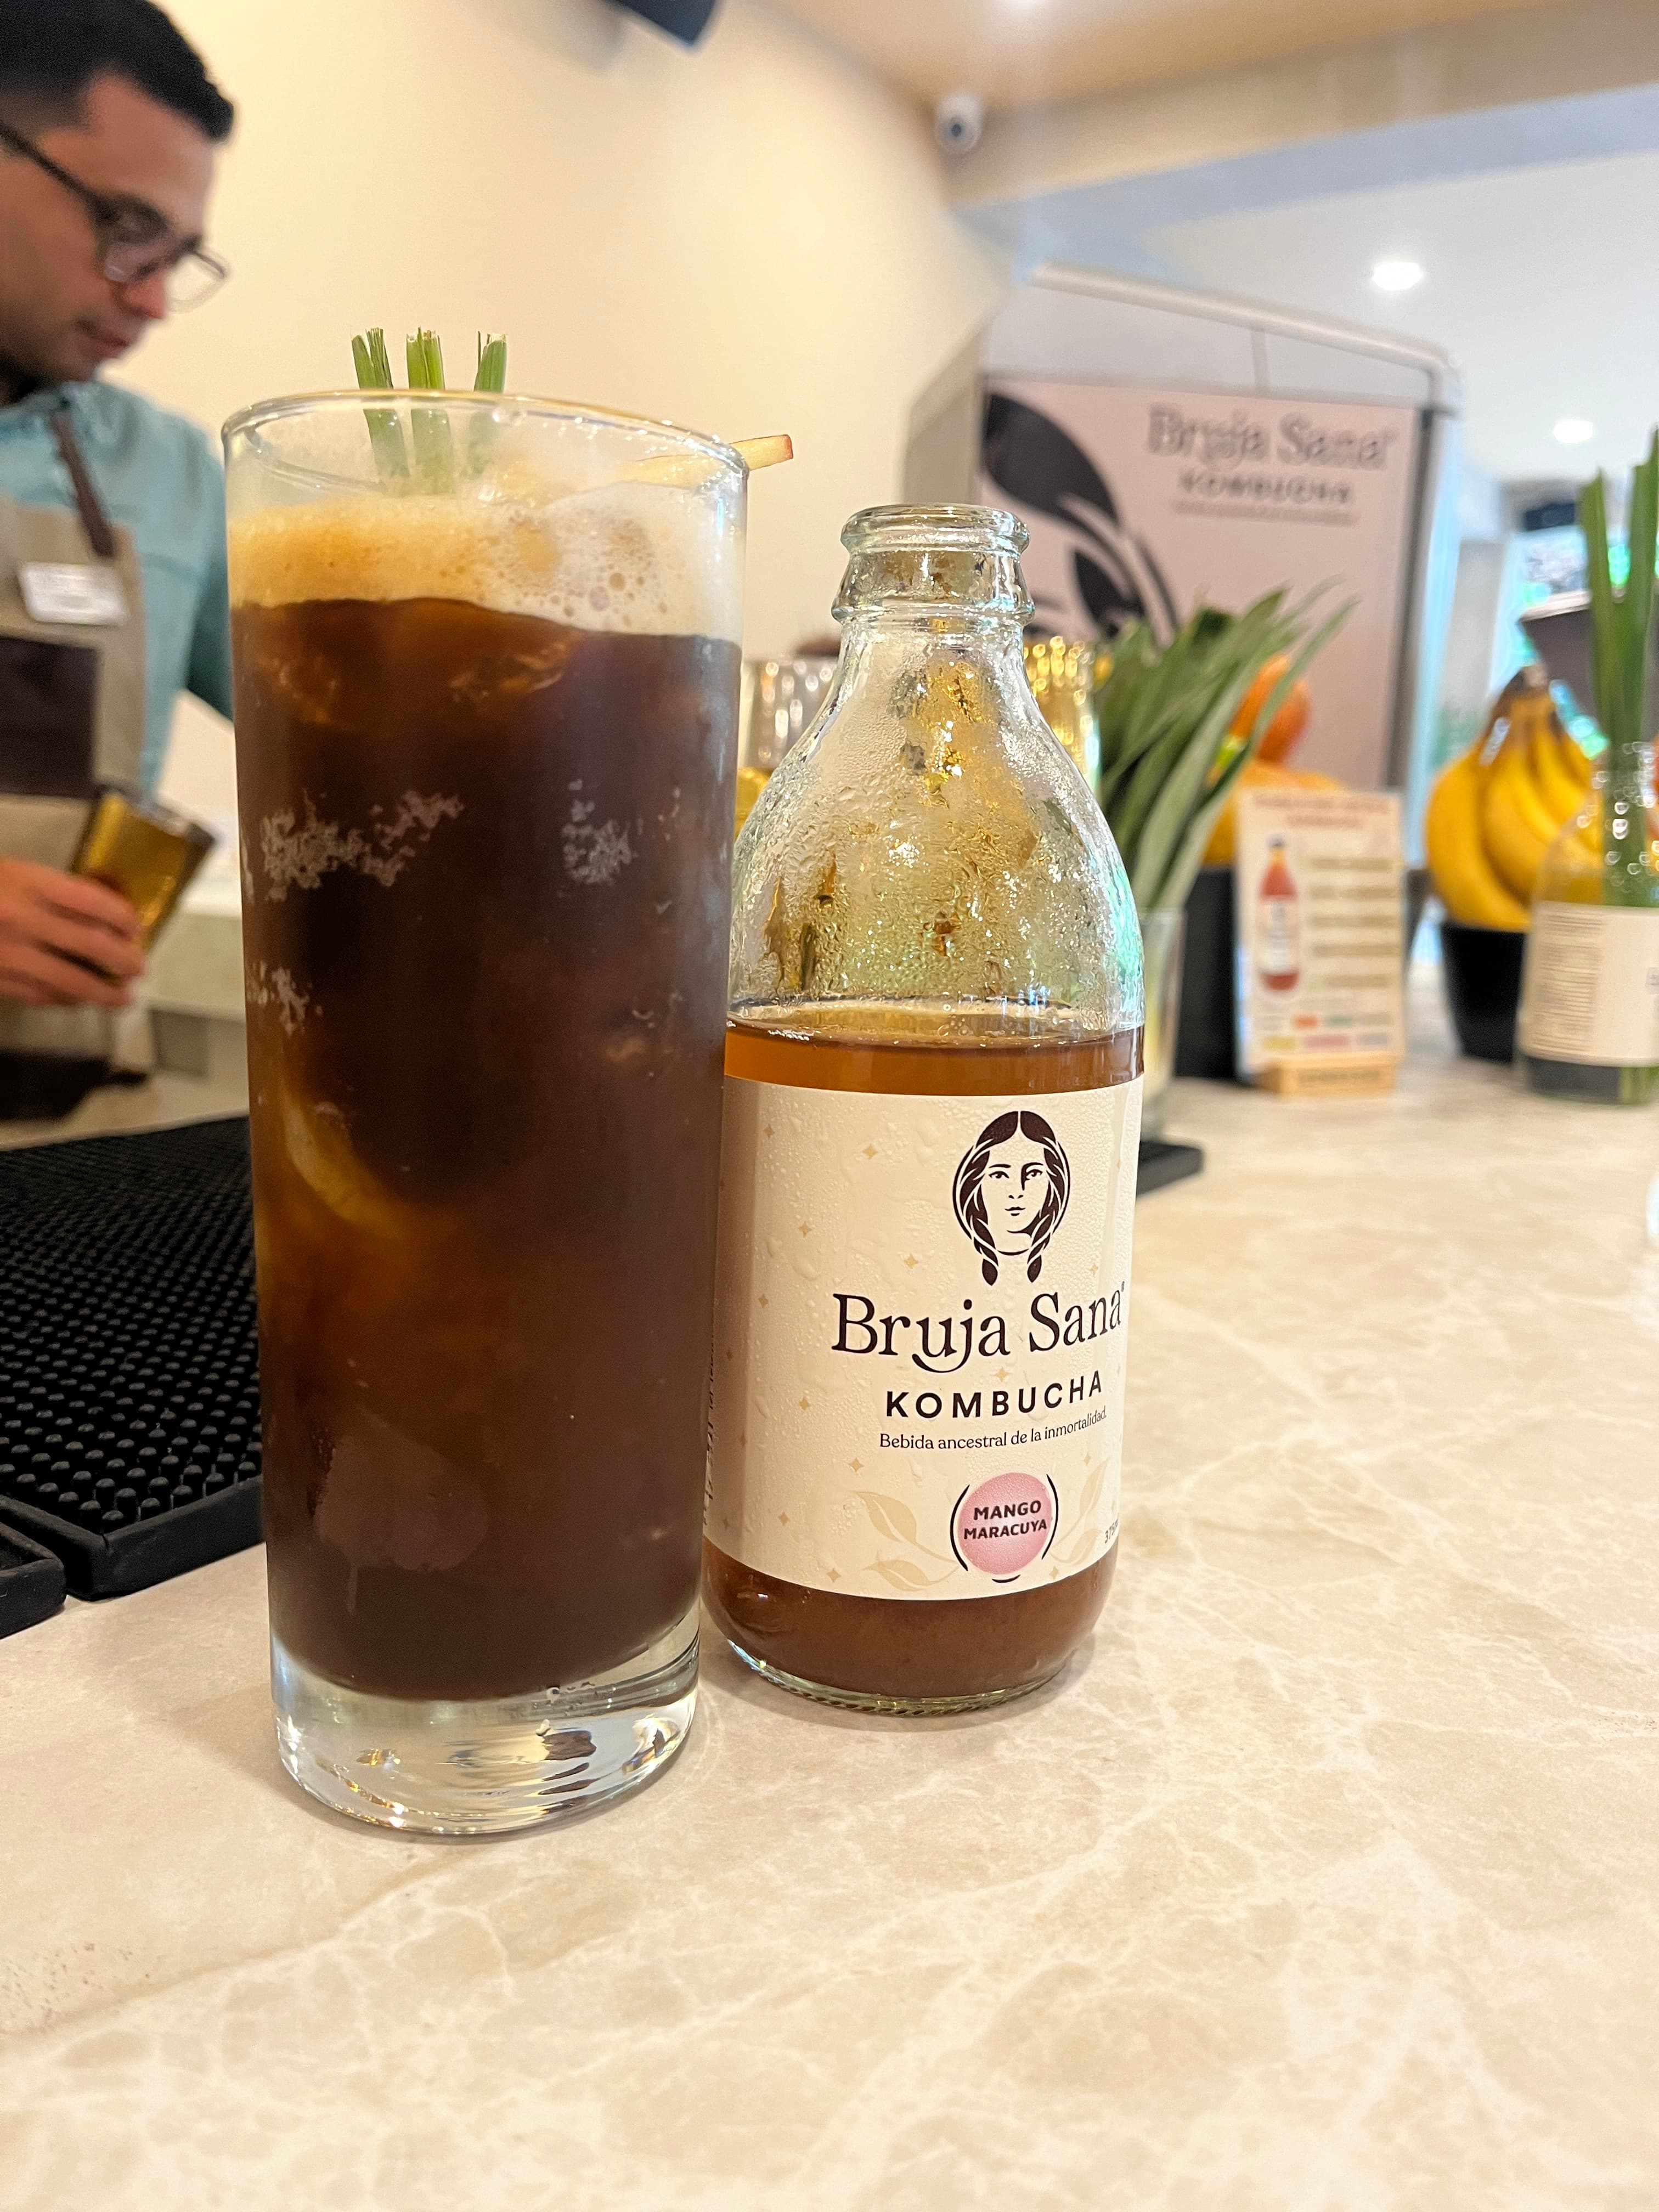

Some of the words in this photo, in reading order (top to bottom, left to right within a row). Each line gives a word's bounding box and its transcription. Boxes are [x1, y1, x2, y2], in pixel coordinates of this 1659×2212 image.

[832, 1293, 1011, 1373] Bruja
[1029, 1290, 1121, 1352] Sana
[885, 1370, 1102, 1419] KOMBUCHA
[880, 1433, 934, 1449] Bebida
[938, 1432, 1007, 1449] ancestral
[1011, 1430, 1028, 1445] de
[1031, 1428, 1041, 1442] la
[973, 1500, 1042, 1520] MANGO
[963, 1519, 1047, 1539] MARACUYA
